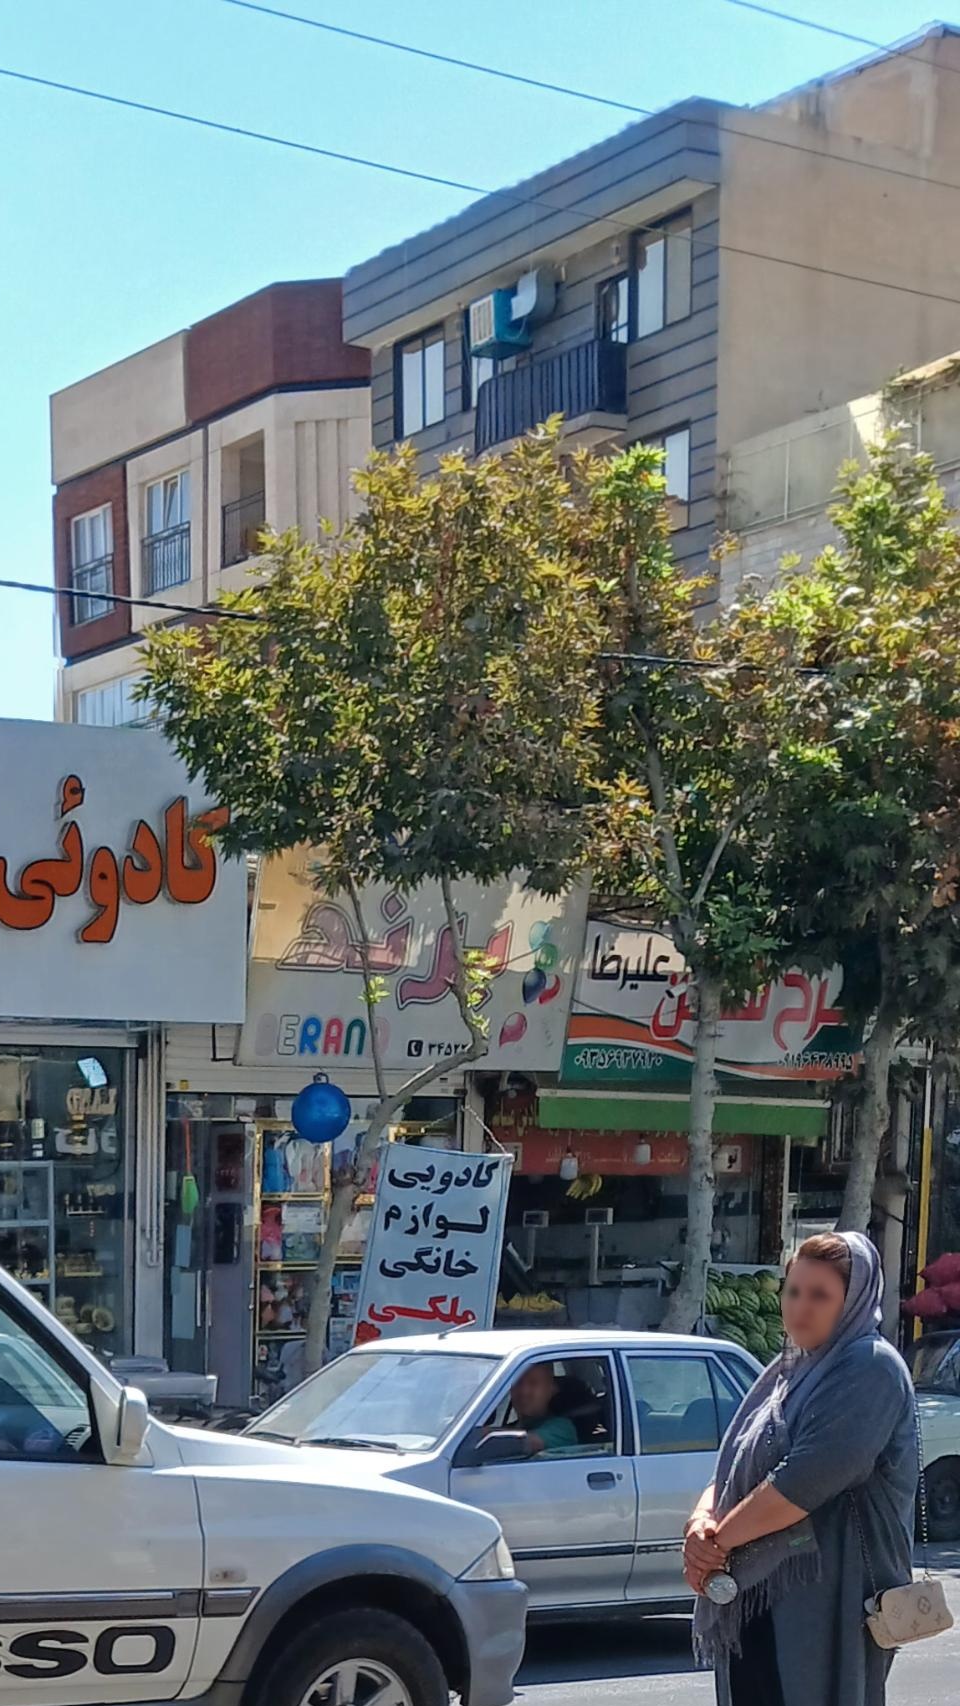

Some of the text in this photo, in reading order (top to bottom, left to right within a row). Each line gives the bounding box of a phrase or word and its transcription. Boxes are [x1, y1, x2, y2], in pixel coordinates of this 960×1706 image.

[590, 934, 671, 991] علیرضا
[388, 1160, 501, 1195] کادویی
[384, 1201, 490, 1240] لوازم
[379, 1246, 479, 1279] خانگی
[367, 1294, 477, 1325] ملکی
